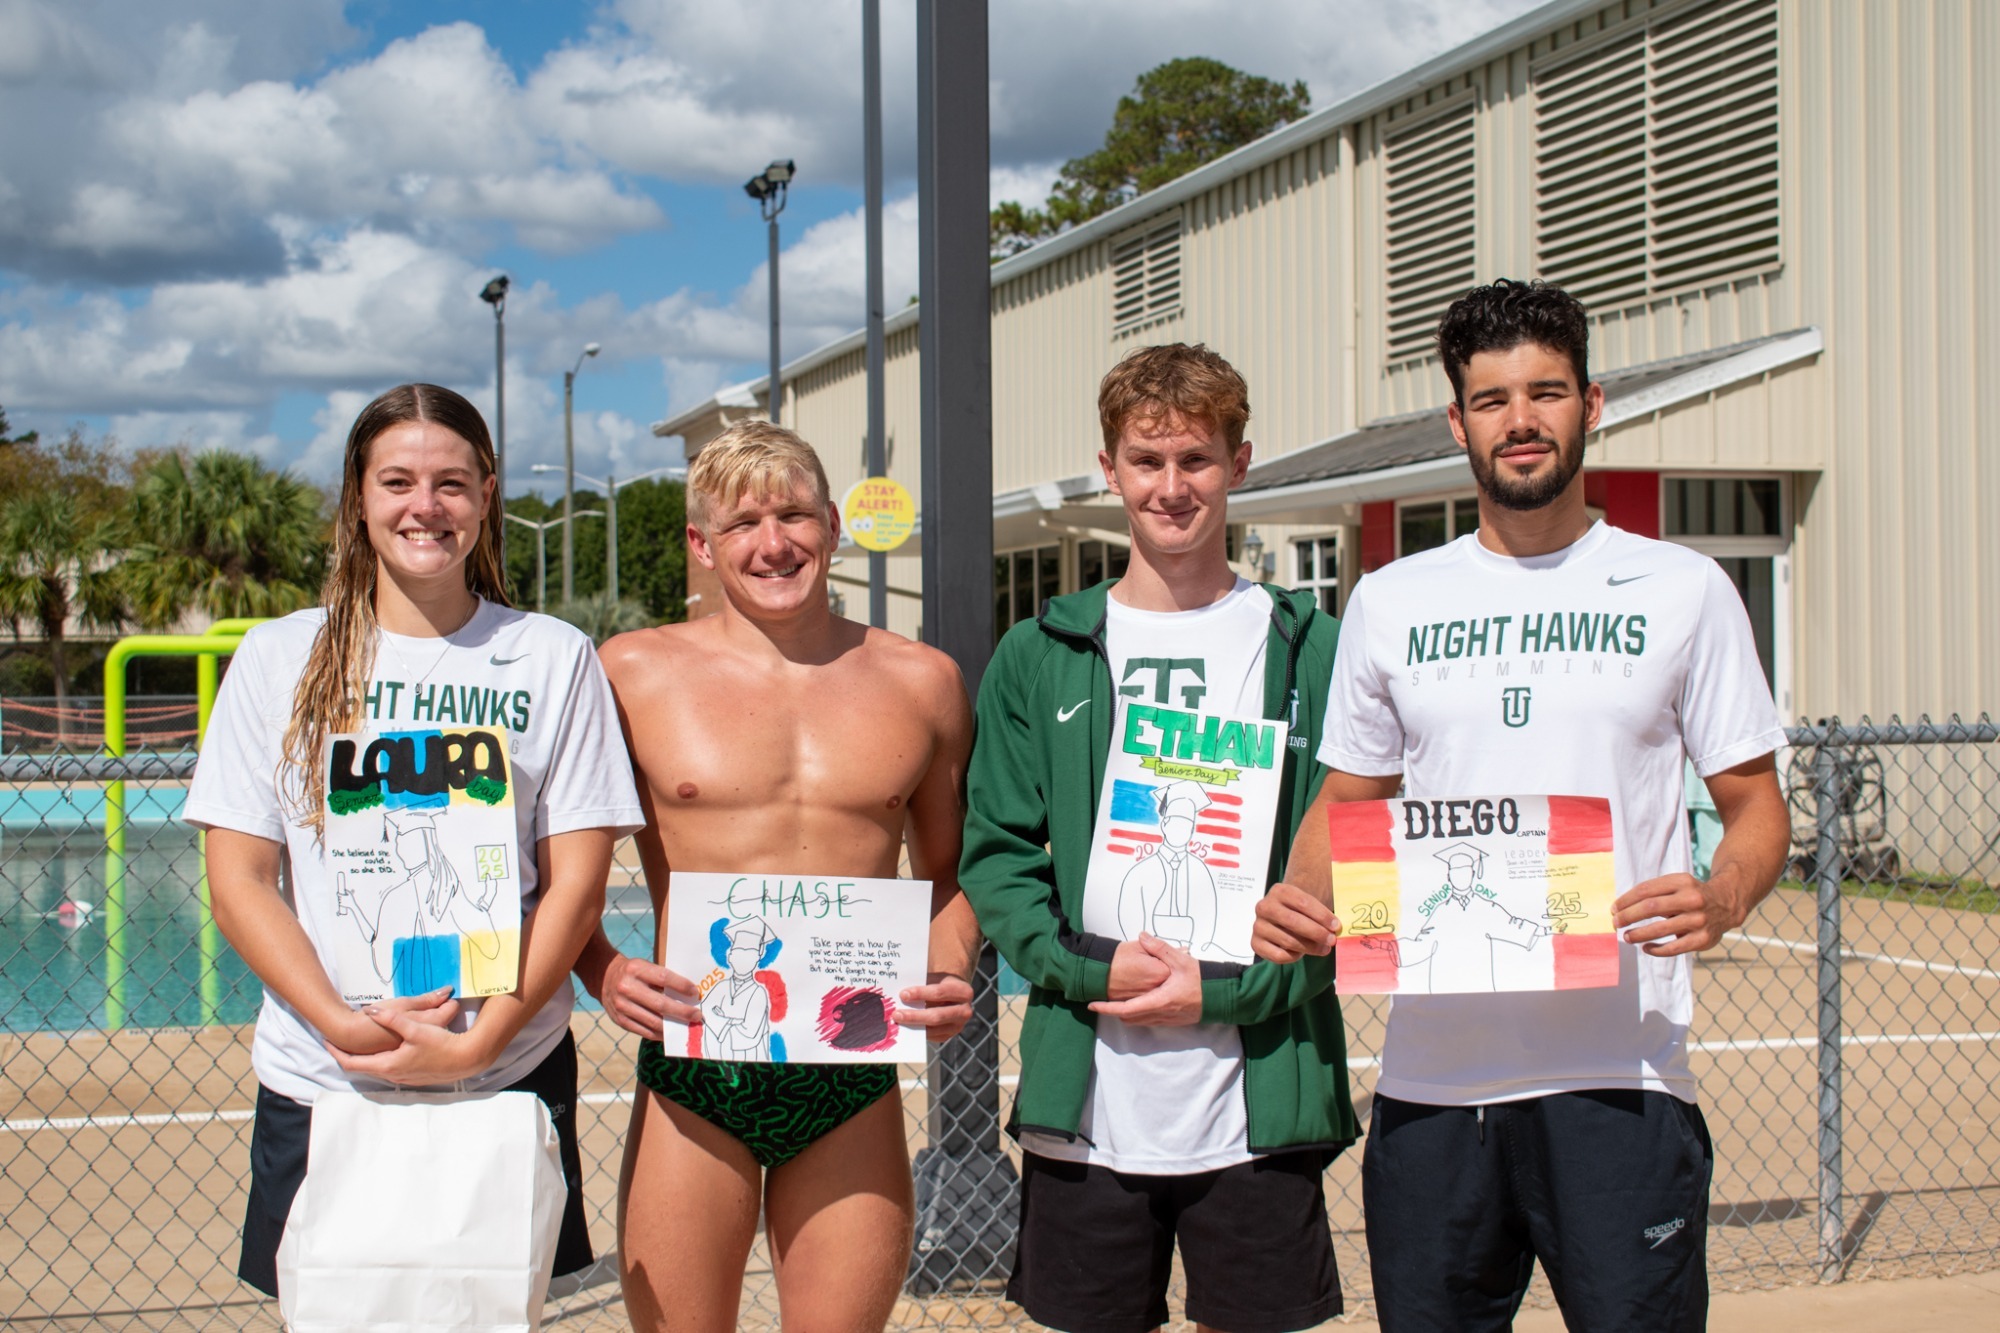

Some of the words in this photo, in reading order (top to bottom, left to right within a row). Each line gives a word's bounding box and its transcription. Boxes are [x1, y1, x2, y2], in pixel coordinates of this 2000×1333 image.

[864, 485, 896, 496] STAY
[857, 499, 903, 511] ALERT!
[1407, 615, 1512, 666] NIGHT
[1520, 612, 1647, 656] HAWKS
[1412, 658, 1633, 686] SWIMMING
[414, 683, 531, 733] HAWKS
[1123, 703, 1275, 769] ETHAN
[330, 731, 507, 795] LAURA
[1158, 764, 1192, 776] Senior
[1193, 768, 1219, 784] Day
[333, 793, 380, 812] Senior
[472, 780, 501, 804] Day
[1402, 798, 1520, 840] DIEGO
[332, 849, 345, 857] She
[479, 847, 502, 863] 20
[1136, 843, 1154, 862] 20
[481, 864, 505, 879] 25
[728, 878, 855, 919] CHASE
[1474, 884, 1497, 899] DAY
[1351, 900, 1388, 929] 20
[1546, 892, 1581, 916] 25
[810, 936, 831, 948] Take
[835, 940, 854, 951] pride
[858, 940, 865, 948] in
[867, 939, 884, 948] how
[887, 940, 902, 951] far
[809, 949, 831, 958] you've
[877, 950, 901, 958] faith
[840, 957, 852, 966] far
[809, 964, 821, 972] But
[825, 966, 842, 974] don't
[845, 967, 866, 976] forget
[879, 969, 897, 980] enjoy
[1644, 1217, 1685, 1239] speedo
